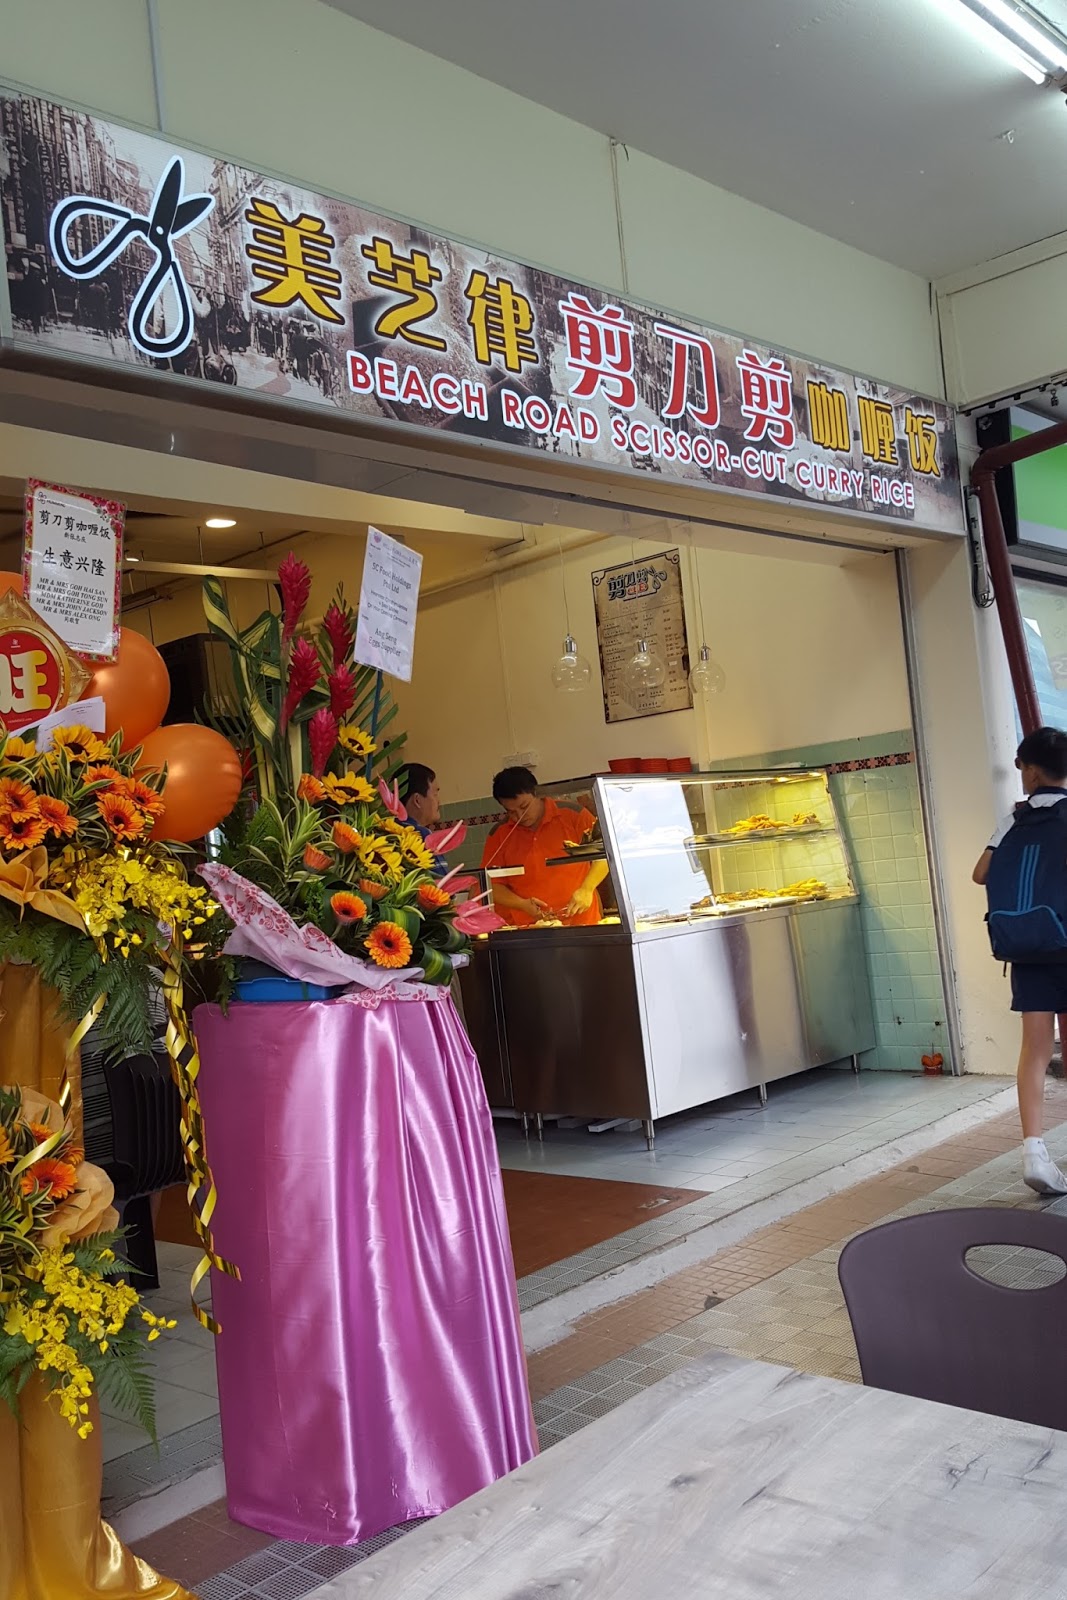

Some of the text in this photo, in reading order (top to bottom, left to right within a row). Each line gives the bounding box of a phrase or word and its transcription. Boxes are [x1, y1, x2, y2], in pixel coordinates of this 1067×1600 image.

[348, 352, 914, 508] BEACH ROAD SCISSOR-CUT CURRY RICE
[39, 509, 111, 540] 剪刀剪咖喱饭
[42, 546, 106, 576] 生意兴隆
[372, 562, 380, 572] SC
[392, 573, 412, 590] Holdings
[40, 577, 49, 585] MR
[70, 584, 83, 592] GOH
[83, 586, 94, 594] HAI
[53, 587, 66, 595] MRS
[81, 592, 96, 601] TONG
[391, 583, 400, 593] Ltd
[41, 591, 104, 609] MDM KATHERINE GOH
[42, 605, 52, 613] MR
[59, 608, 72, 616] MRS
[72, 610, 87, 619] ALEX
[66, 603, 81, 611] JOHN
[82, 605, 108, 616] JACKSON
[375, 628, 398, 645] Ang Seng
[368, 636, 401, 656] Eggs Supplier
